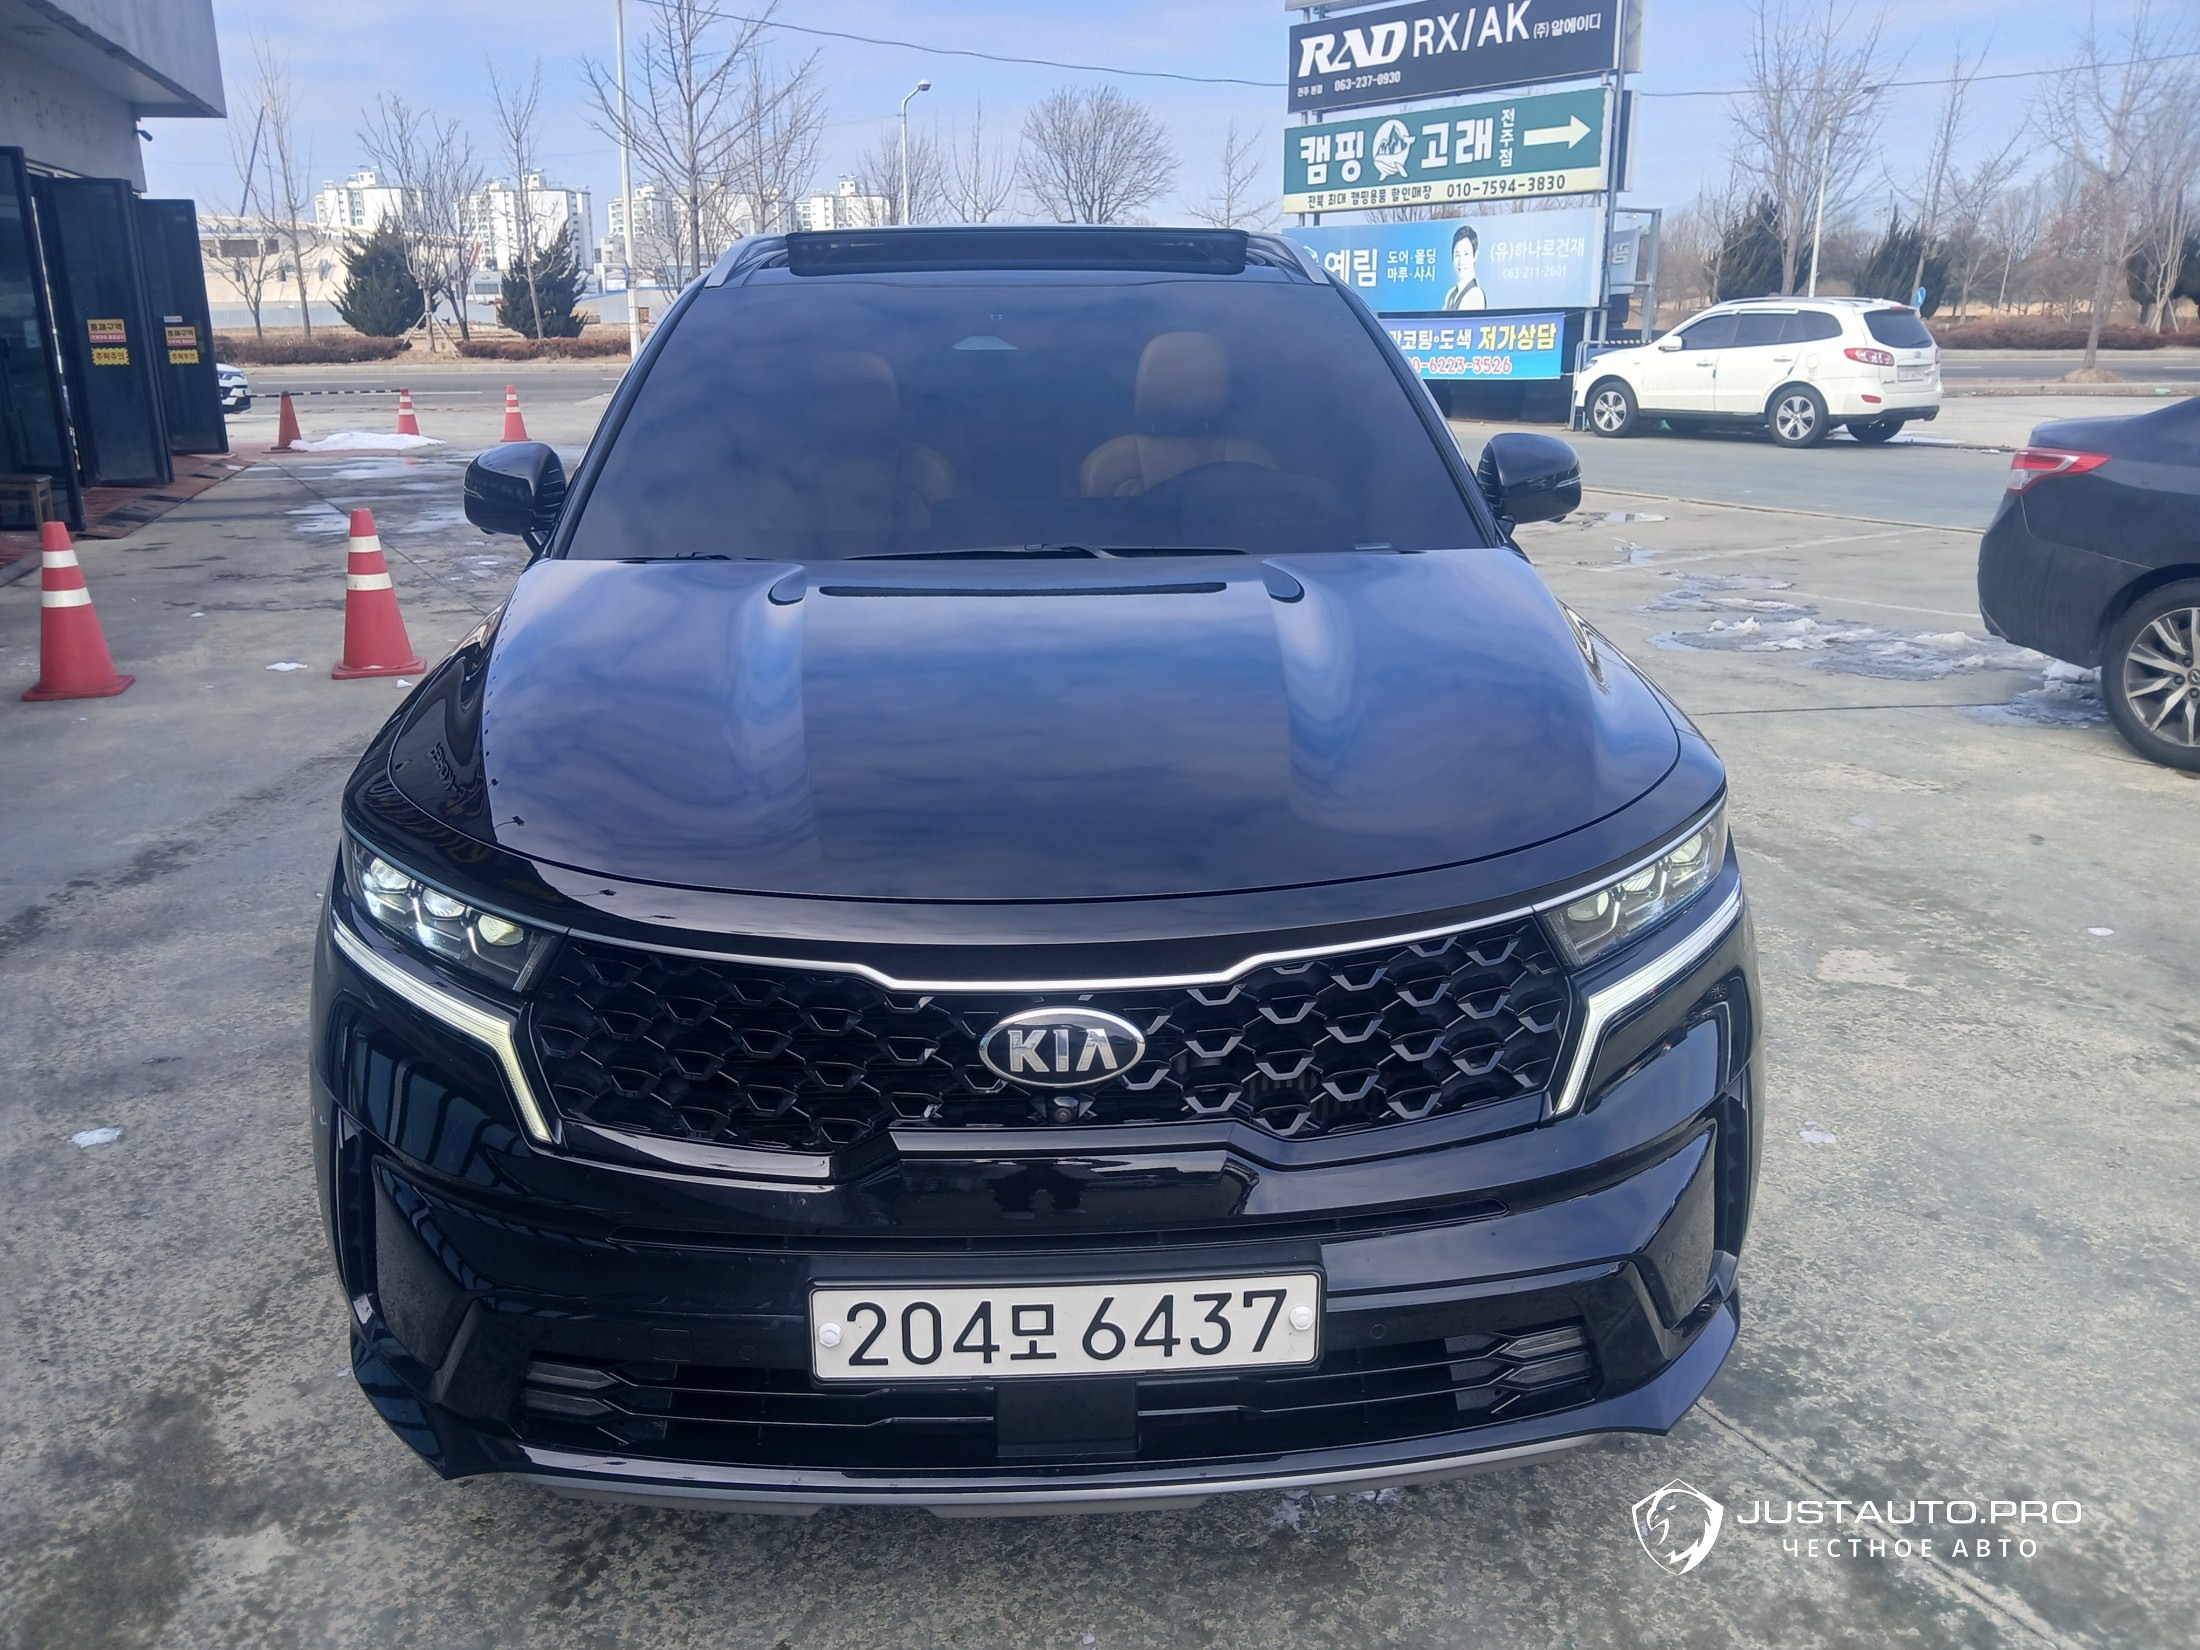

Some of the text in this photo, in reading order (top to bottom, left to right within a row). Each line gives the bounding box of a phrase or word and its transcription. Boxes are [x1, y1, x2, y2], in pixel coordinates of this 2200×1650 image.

[1297, 19, 1409, 78] RAD
[1413, 0, 1533, 58] RX/AK
[1334, 70, 1401, 92] 063-237-0930
[1300, 117, 1495, 185] 캠핑 고래
[1498, 107, 1515, 168] 전주점
[1307, 175, 1567, 209] 전북 최대 캠핑용품 할인매장 010-7594-3830
[1323, 248, 1378, 287] 예림
[1478, 323, 1557, 351] 저가상담
[1408, 355, 1513, 375] 0-6223-3526
[1007, 1028, 1118, 1072] KIA
[845, 1288, 1288, 1366] 204모 6437
